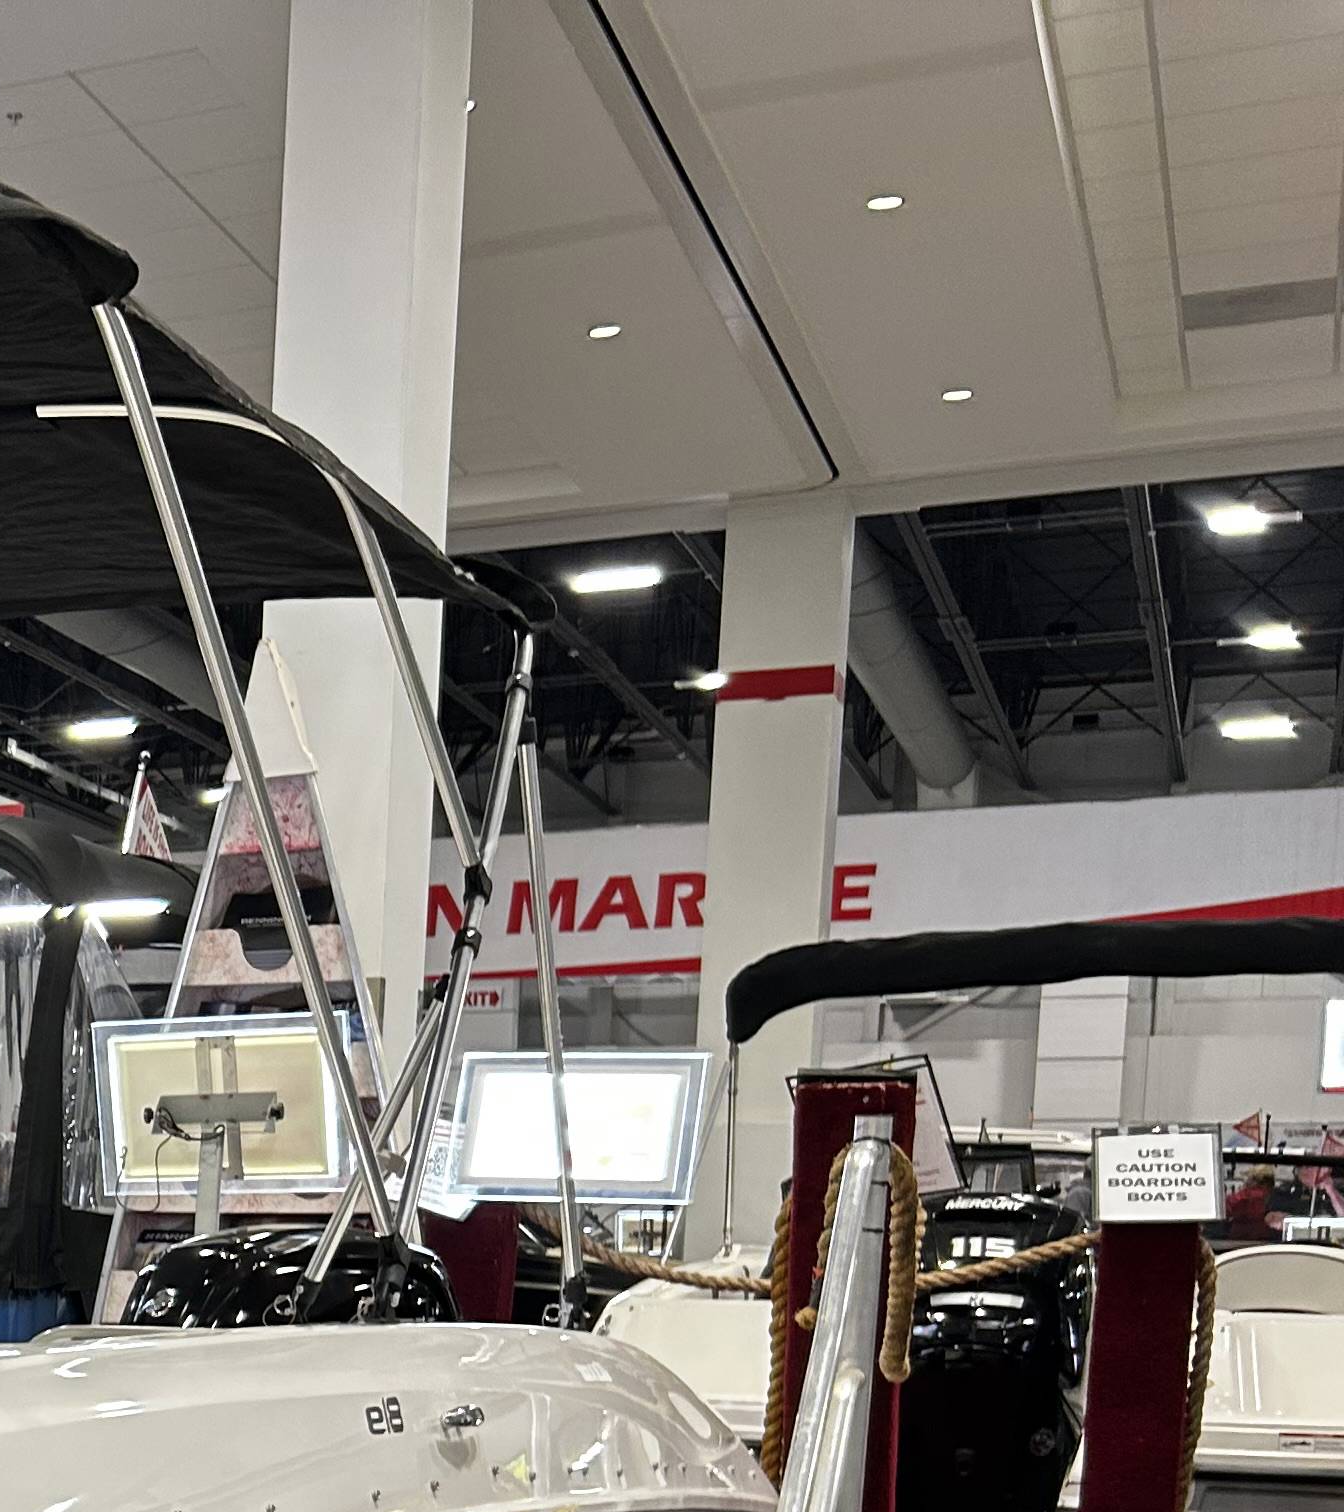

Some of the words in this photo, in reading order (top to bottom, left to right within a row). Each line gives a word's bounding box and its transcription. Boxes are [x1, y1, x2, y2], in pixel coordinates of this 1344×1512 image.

[464, 991, 489, 1007] XIT
[1138, 1149, 1175, 1158] USE
[1115, 1163, 1197, 1173] CAUTION
[1107, 1177, 1207, 1188] BOARDING
[1127, 1192, 1188, 1202] BOATS
[945, 1196, 1025, 1212] MERCURY
[951, 1236, 1016, 1259] 115
